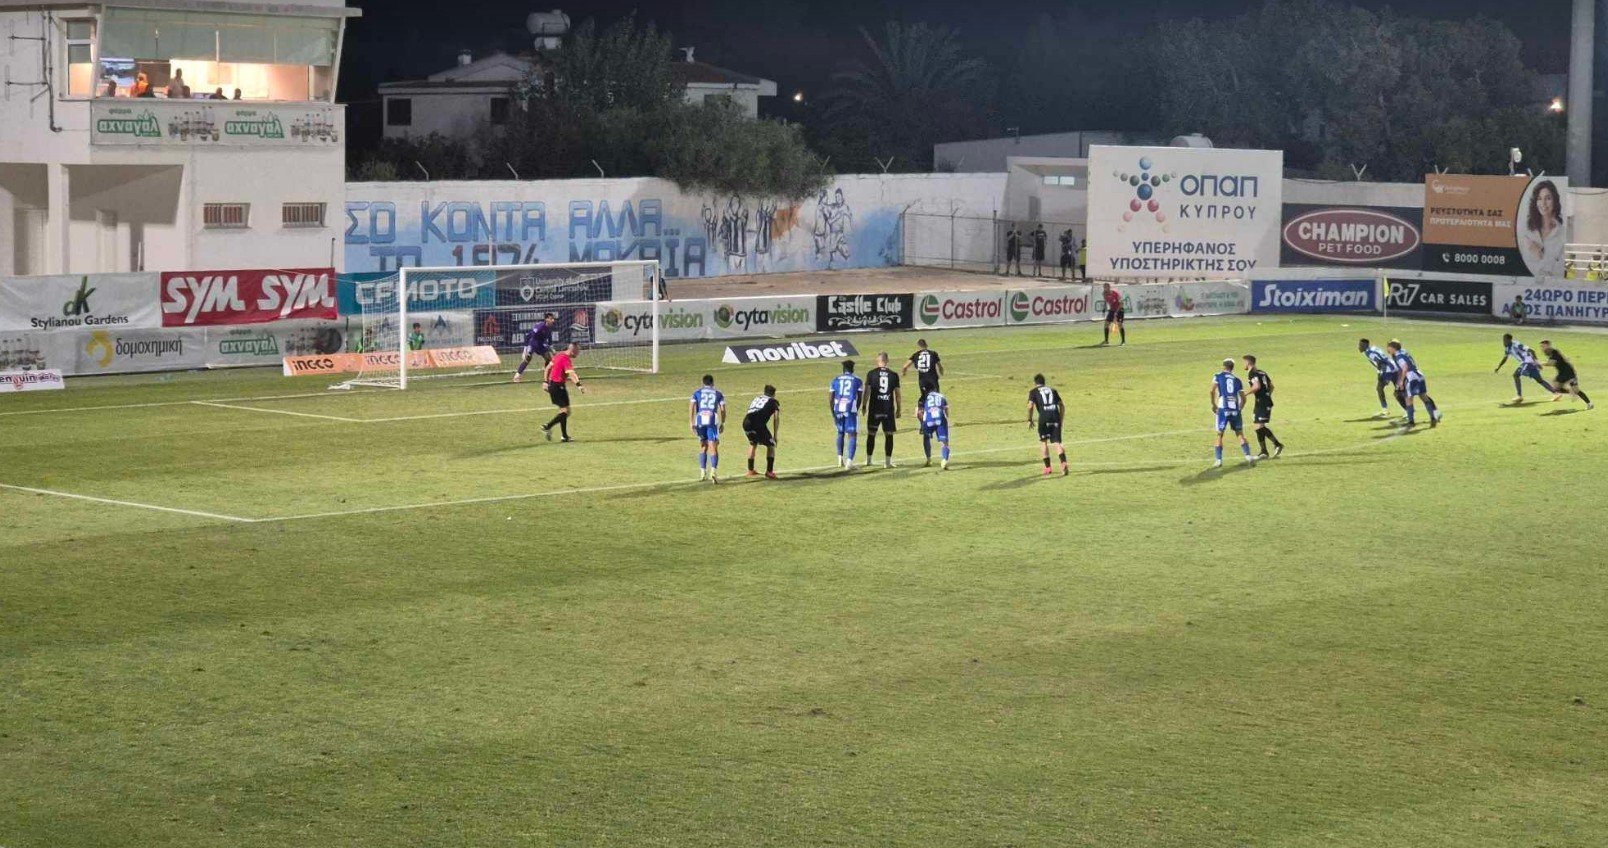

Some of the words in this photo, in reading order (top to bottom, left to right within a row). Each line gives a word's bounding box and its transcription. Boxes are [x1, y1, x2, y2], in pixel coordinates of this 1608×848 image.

[1180, 204, 1256, 219] ΚΥΠΡΟΥ
[421, 200, 546, 243] ΚΟΝΤΑ
[1298, 222, 1405, 244] CHAMPION
[1132, 241, 1237, 255] ΥΠΕΡΗΦΑΝΟΣ
[1318, 242, 1343, 253] PET
[1346, 244, 1382, 255] FOOD
[1110, 257, 1225, 271] ΥΠΟΣΤΗΡΙΚΤΗΣ
[1227, 259, 1257, 272] ΣΟΥ
[1454, 253, 1479, 263] 8000
[162, 276, 246, 324] SYM
[257, 273, 335, 319] SYM
[1259, 284, 1368, 307] Stoiximan
[1420, 293, 1444, 304] CAR
[1449, 294, 1487, 306] SALES
[1524, 289, 1573, 302] 24ΩΡΟ
[828, 296, 872, 315] Castle
[942, 297, 1002, 320] Castrol
[1032, 294, 1088, 316] Castrol
[31, 317, 81, 330] Stylianou
[84, 315, 129, 326] Gardens
[735, 302, 809, 331] cytavision
[115, 337, 183, 359] δομοχημική
[745, 341, 848, 362] novibet
[918, 355, 931, 370] 21
[839, 379, 852, 396] 12
[879, 376, 889, 394] 9
[700, 393, 716, 409] 22
[1038, 387, 1054, 405] 17
